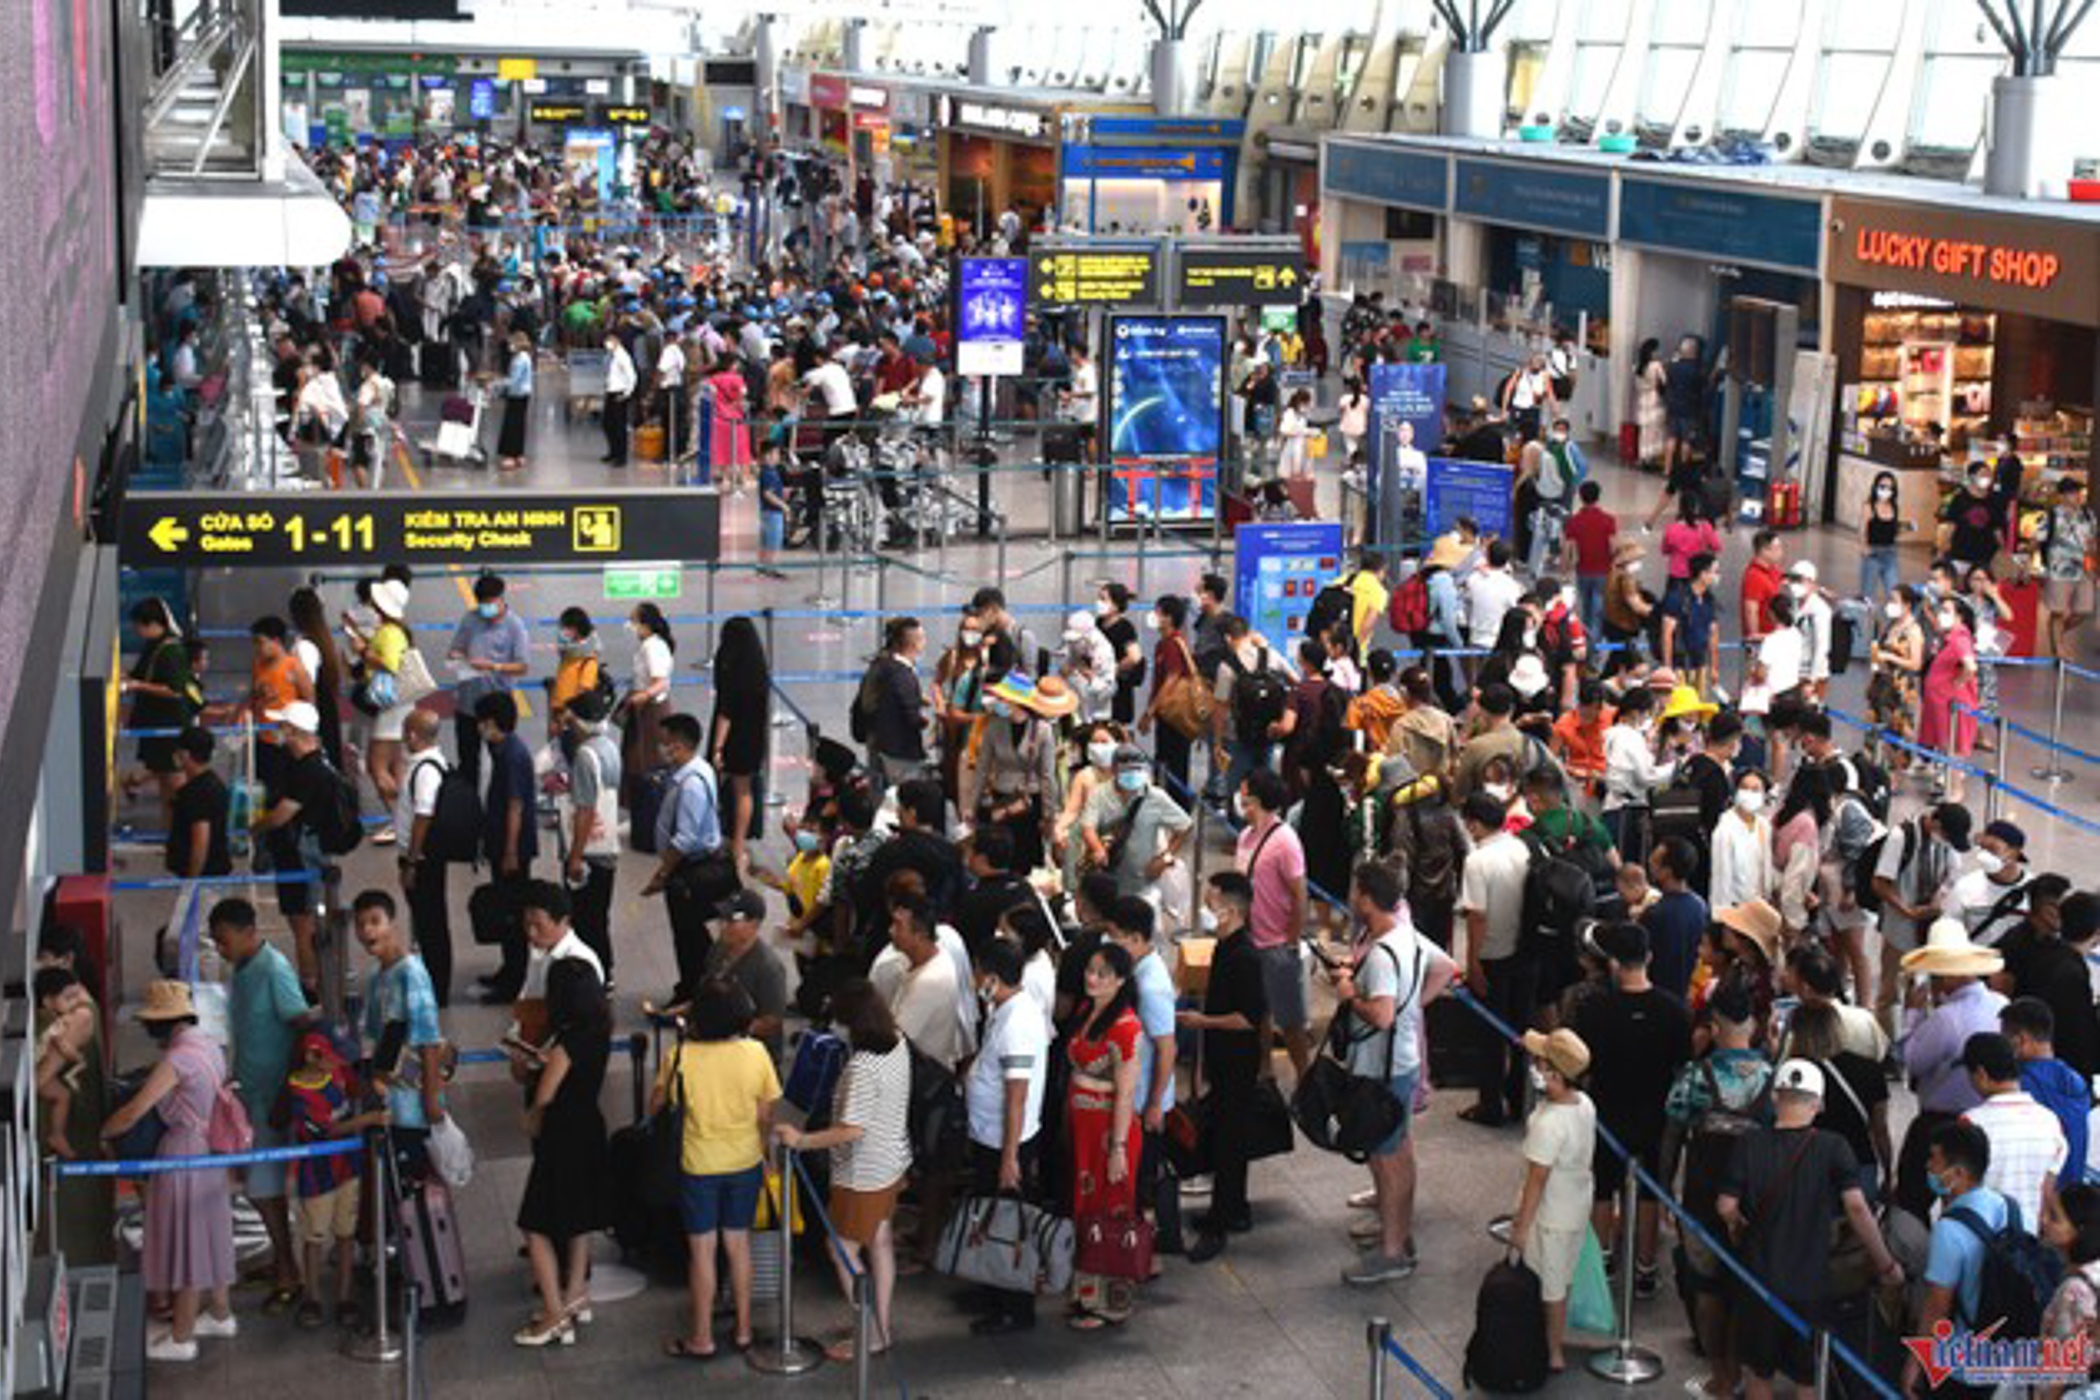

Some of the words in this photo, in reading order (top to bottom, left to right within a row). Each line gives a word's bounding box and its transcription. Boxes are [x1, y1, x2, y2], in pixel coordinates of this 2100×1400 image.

[1856, 226, 1930, 269] LUCKY
[1933, 240, 1985, 277] GIFT
[1990, 248, 2058, 286] SHOP
